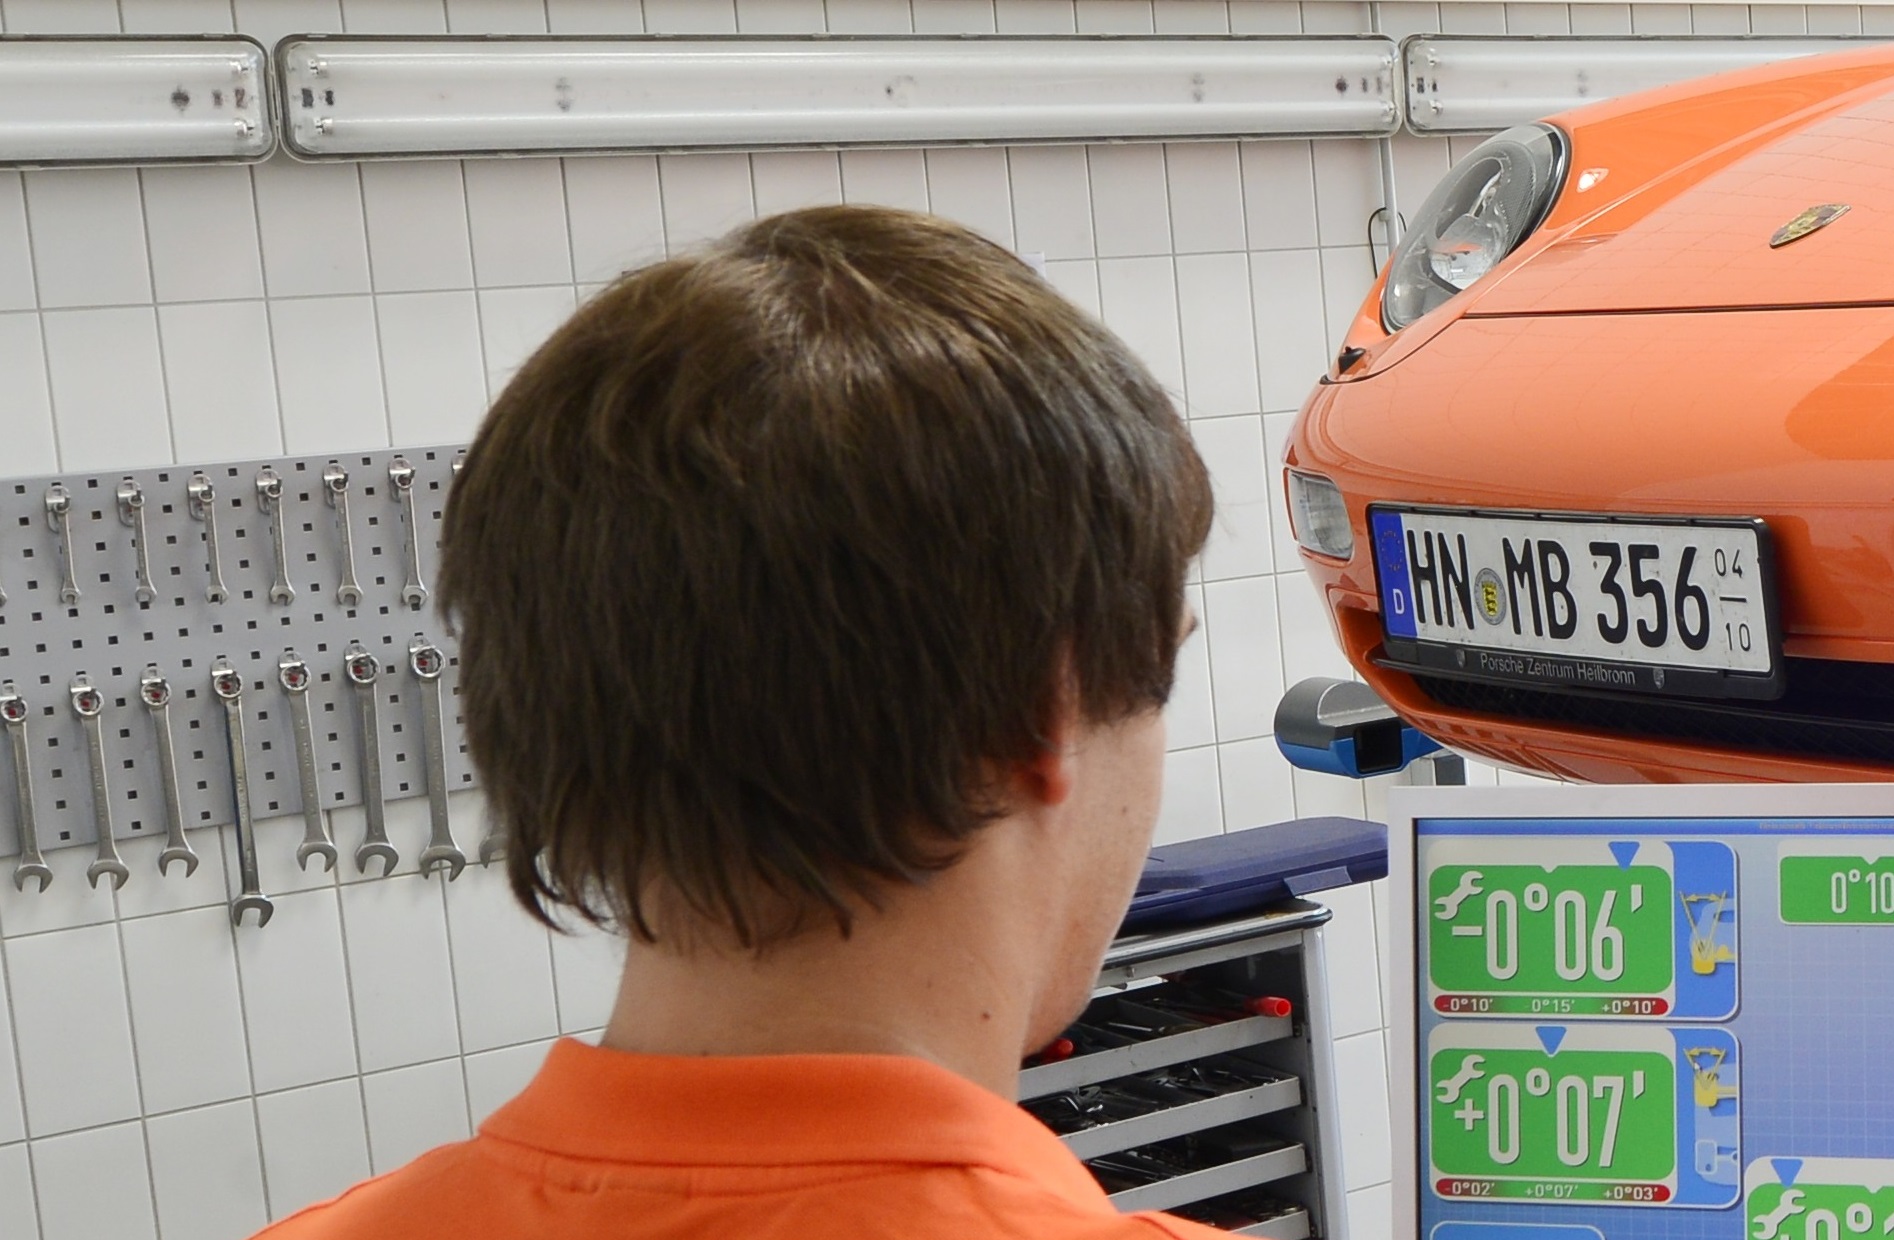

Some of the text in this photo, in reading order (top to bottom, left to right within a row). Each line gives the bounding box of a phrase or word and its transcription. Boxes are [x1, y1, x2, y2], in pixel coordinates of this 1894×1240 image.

[1714, 548, 1744, 578] 04
[1392, 588, 1405, 615] D
[1406, 530, 1475, 630] HN
[1502, 537, 1578, 640] MB
[1589, 542, 1711, 651] 356
[1725, 622, 1752, 652] 10
[1480, 652, 1636, 685] Porsche Zentrum Heilbronn
